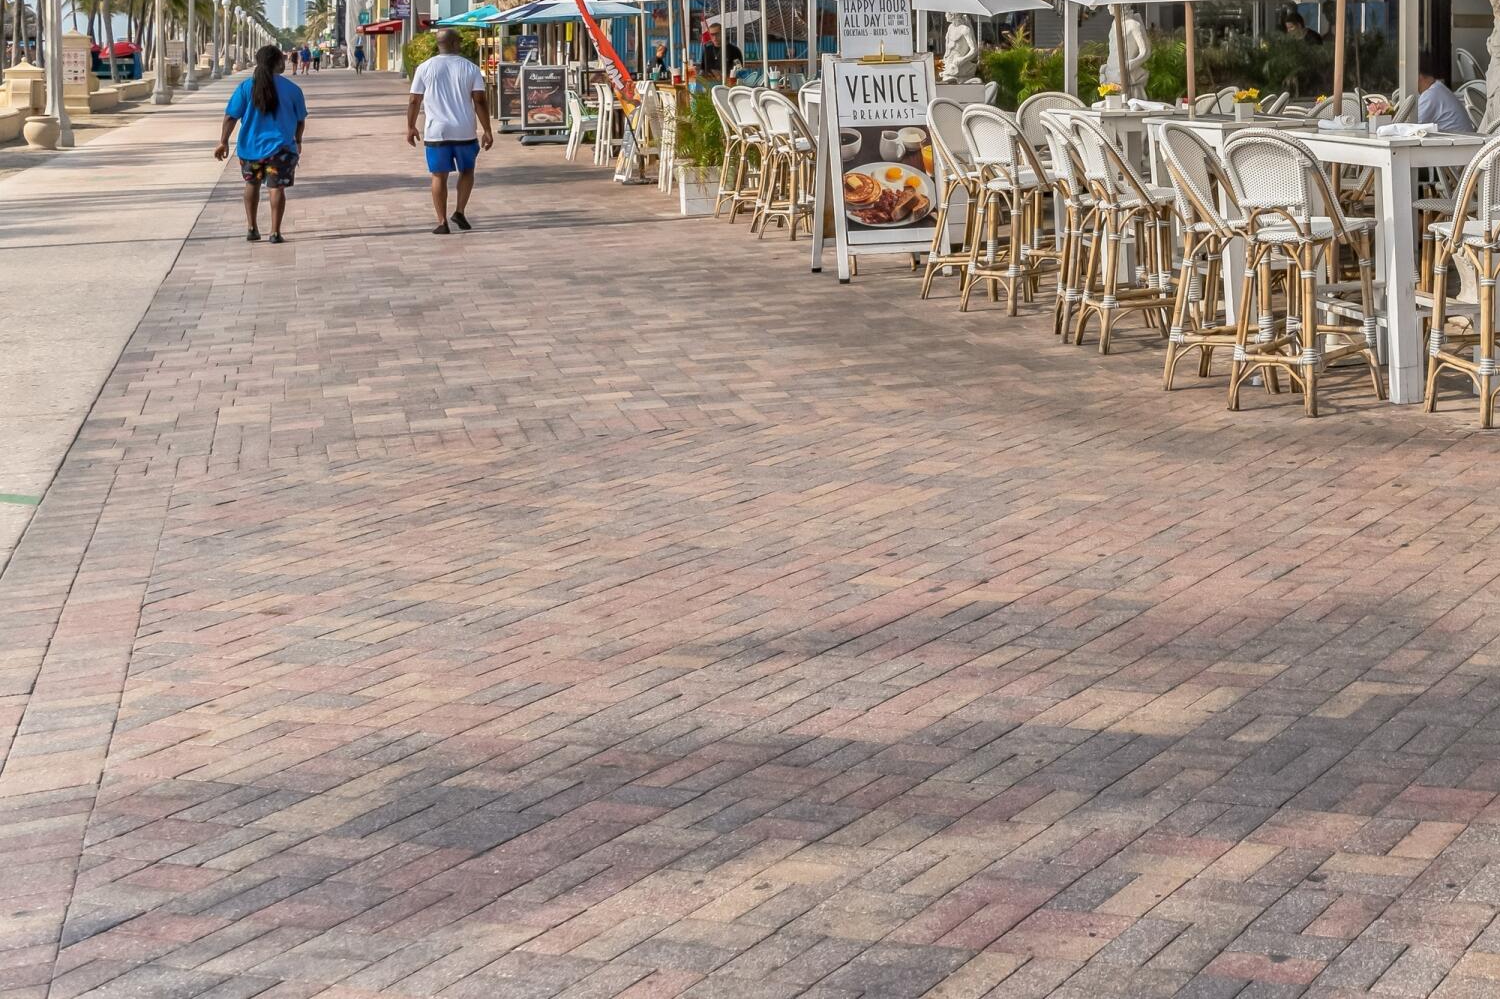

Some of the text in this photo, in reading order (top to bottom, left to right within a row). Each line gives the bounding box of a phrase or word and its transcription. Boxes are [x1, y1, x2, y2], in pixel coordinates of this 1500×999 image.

[843, 0, 907, 13] HAPPY HOUR
[844, 13, 881, 28] ALL DAY
[843, 28, 869, 37] COCKTAILS
[892, 28, 910, 36] WINES
[845, 74, 919, 104] VENICE
[852, 108, 916, 120] BREAKFAST
